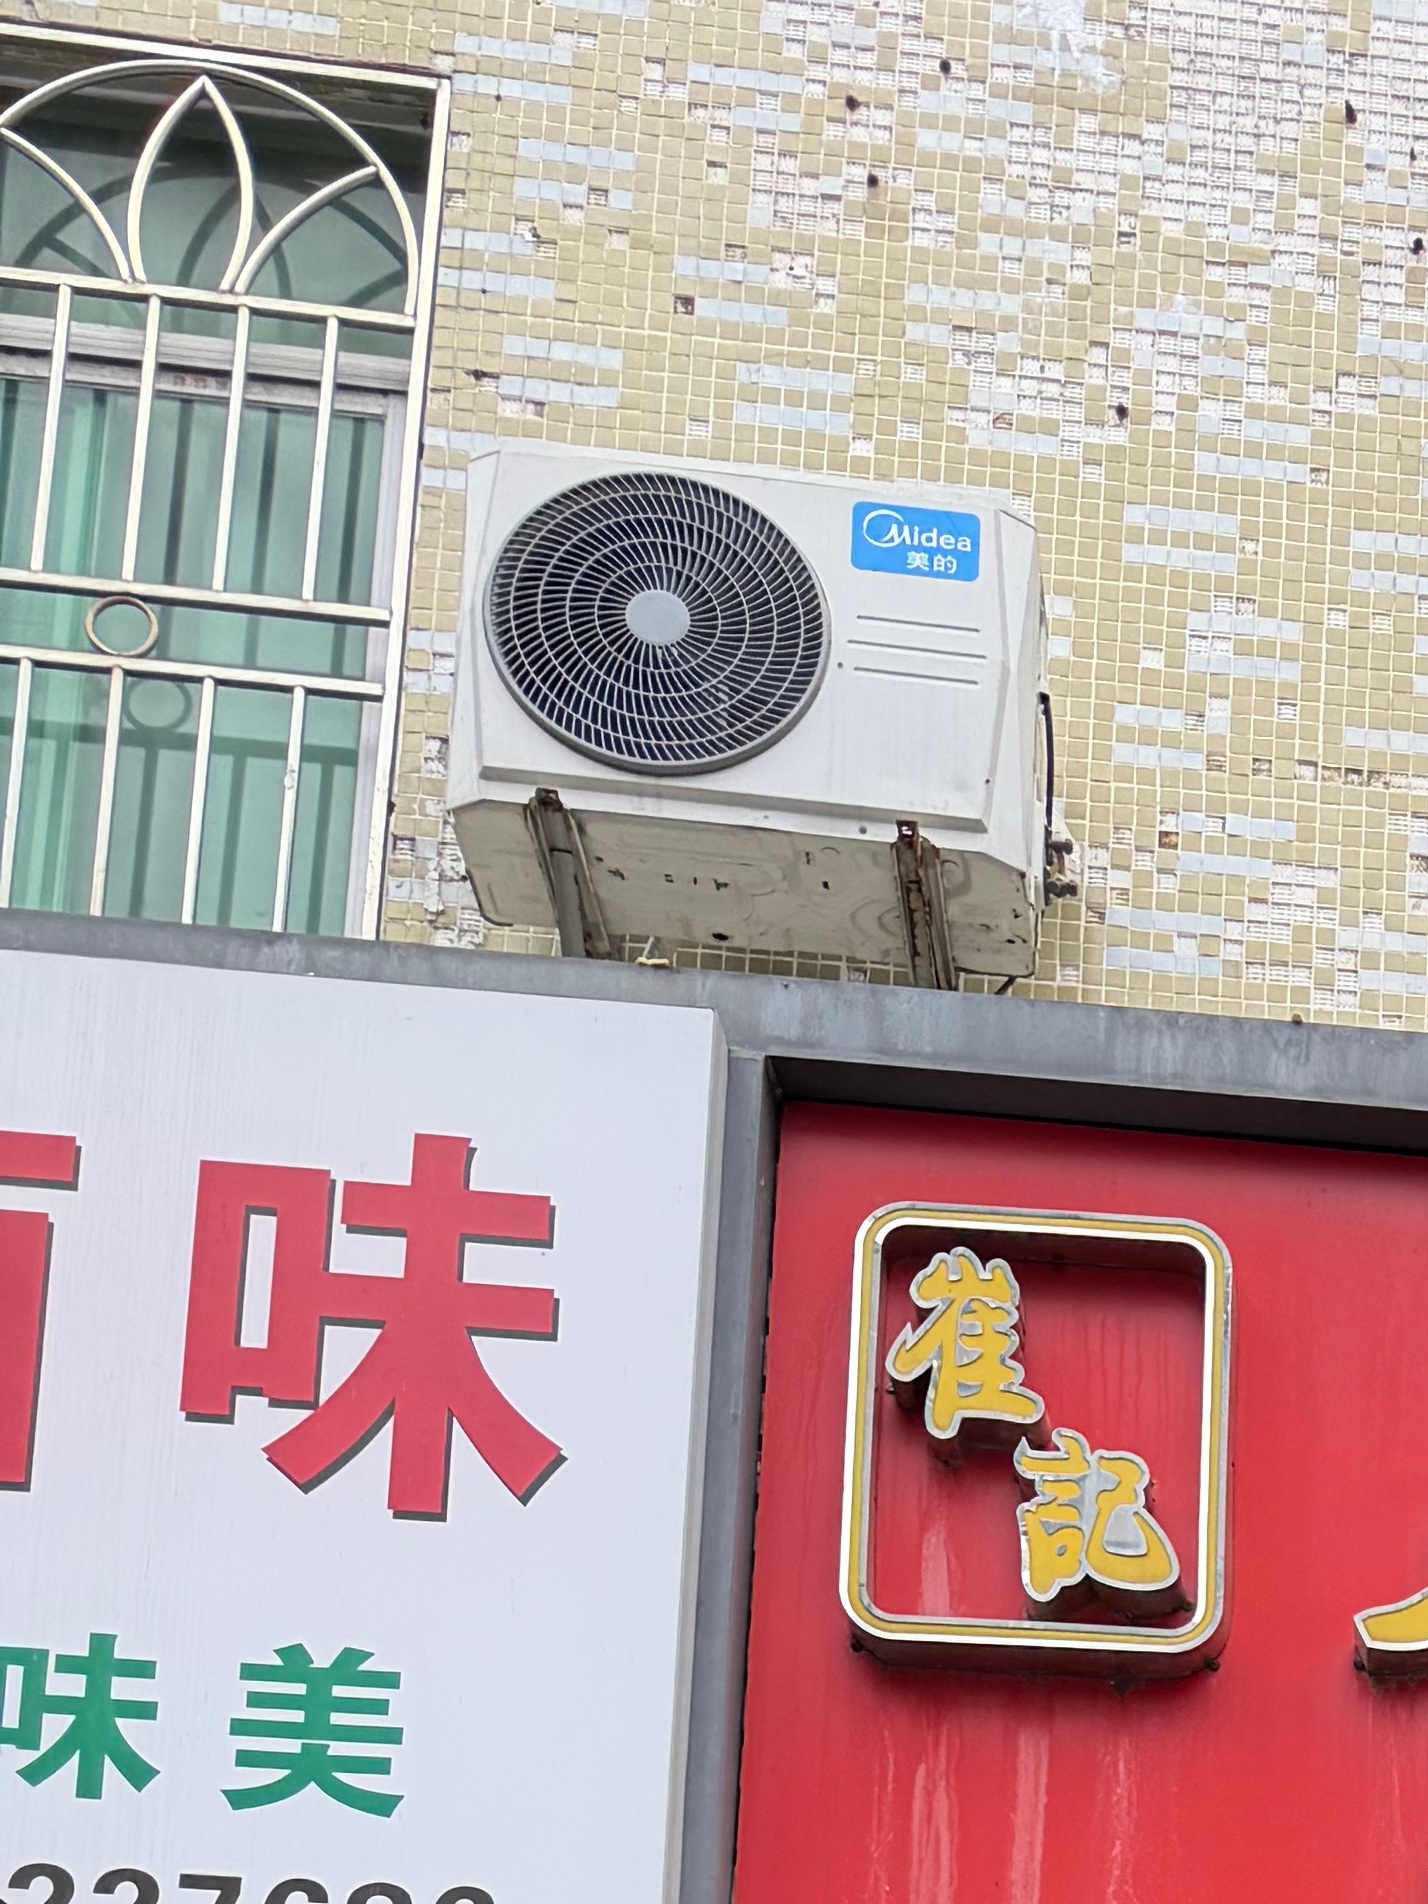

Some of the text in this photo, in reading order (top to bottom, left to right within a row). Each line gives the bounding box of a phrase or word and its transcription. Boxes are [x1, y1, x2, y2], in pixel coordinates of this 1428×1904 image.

[863, 509, 972, 552] Midea
[906, 551, 957, 574] 美的
[0, 1132, 566, 1522] 味
